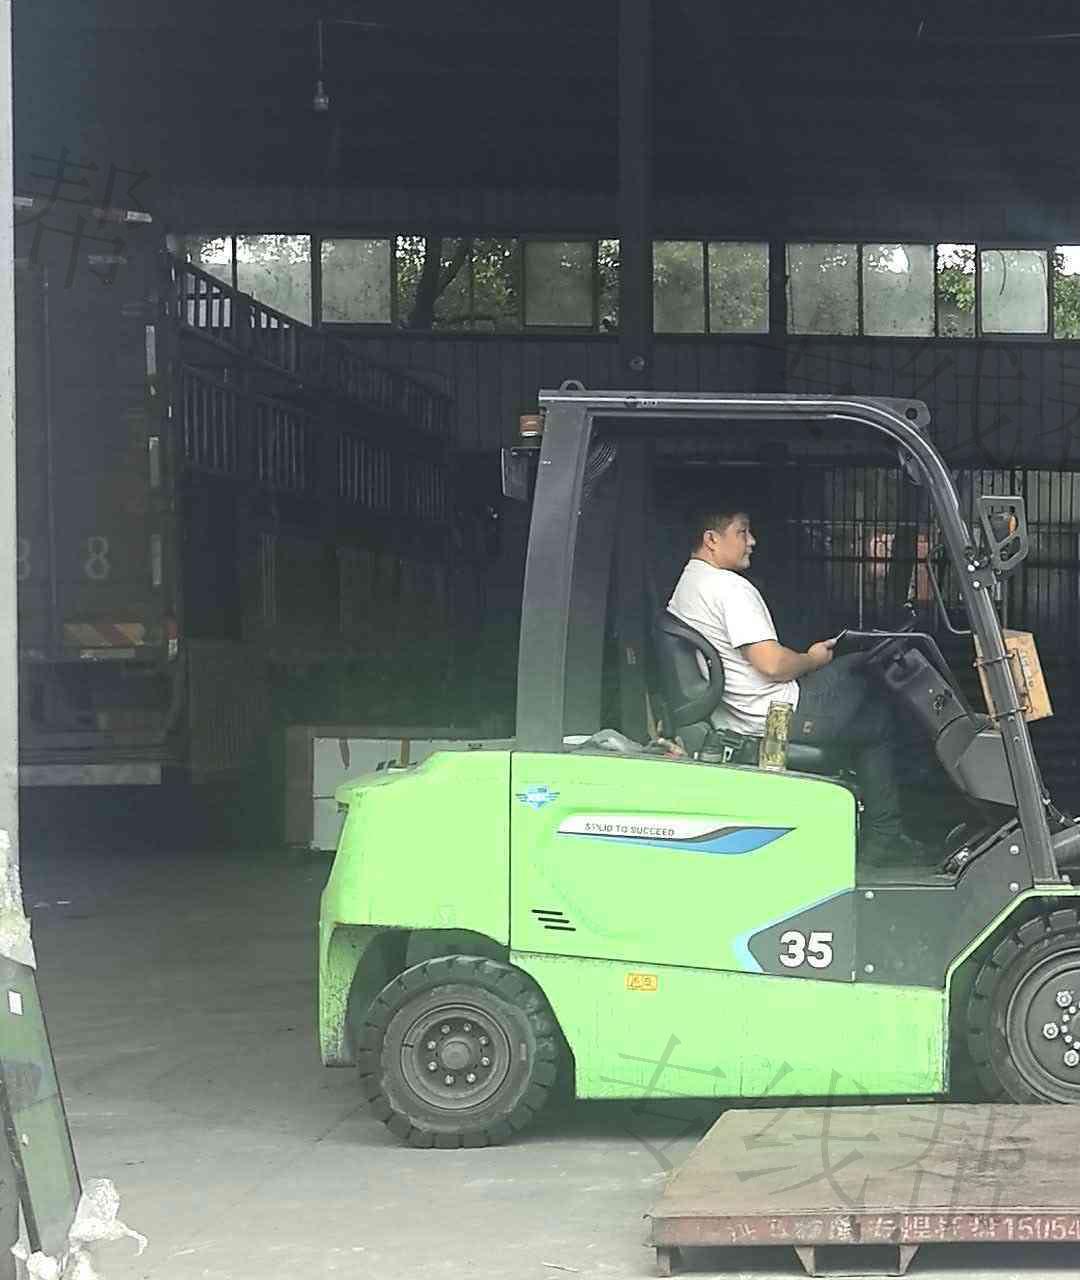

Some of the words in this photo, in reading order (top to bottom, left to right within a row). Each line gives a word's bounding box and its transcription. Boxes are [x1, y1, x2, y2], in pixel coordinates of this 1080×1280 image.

[616, 824, 628, 834] TO
[631, 825, 675, 837] SUCCEED
[778, 930, 834, 969] 35
